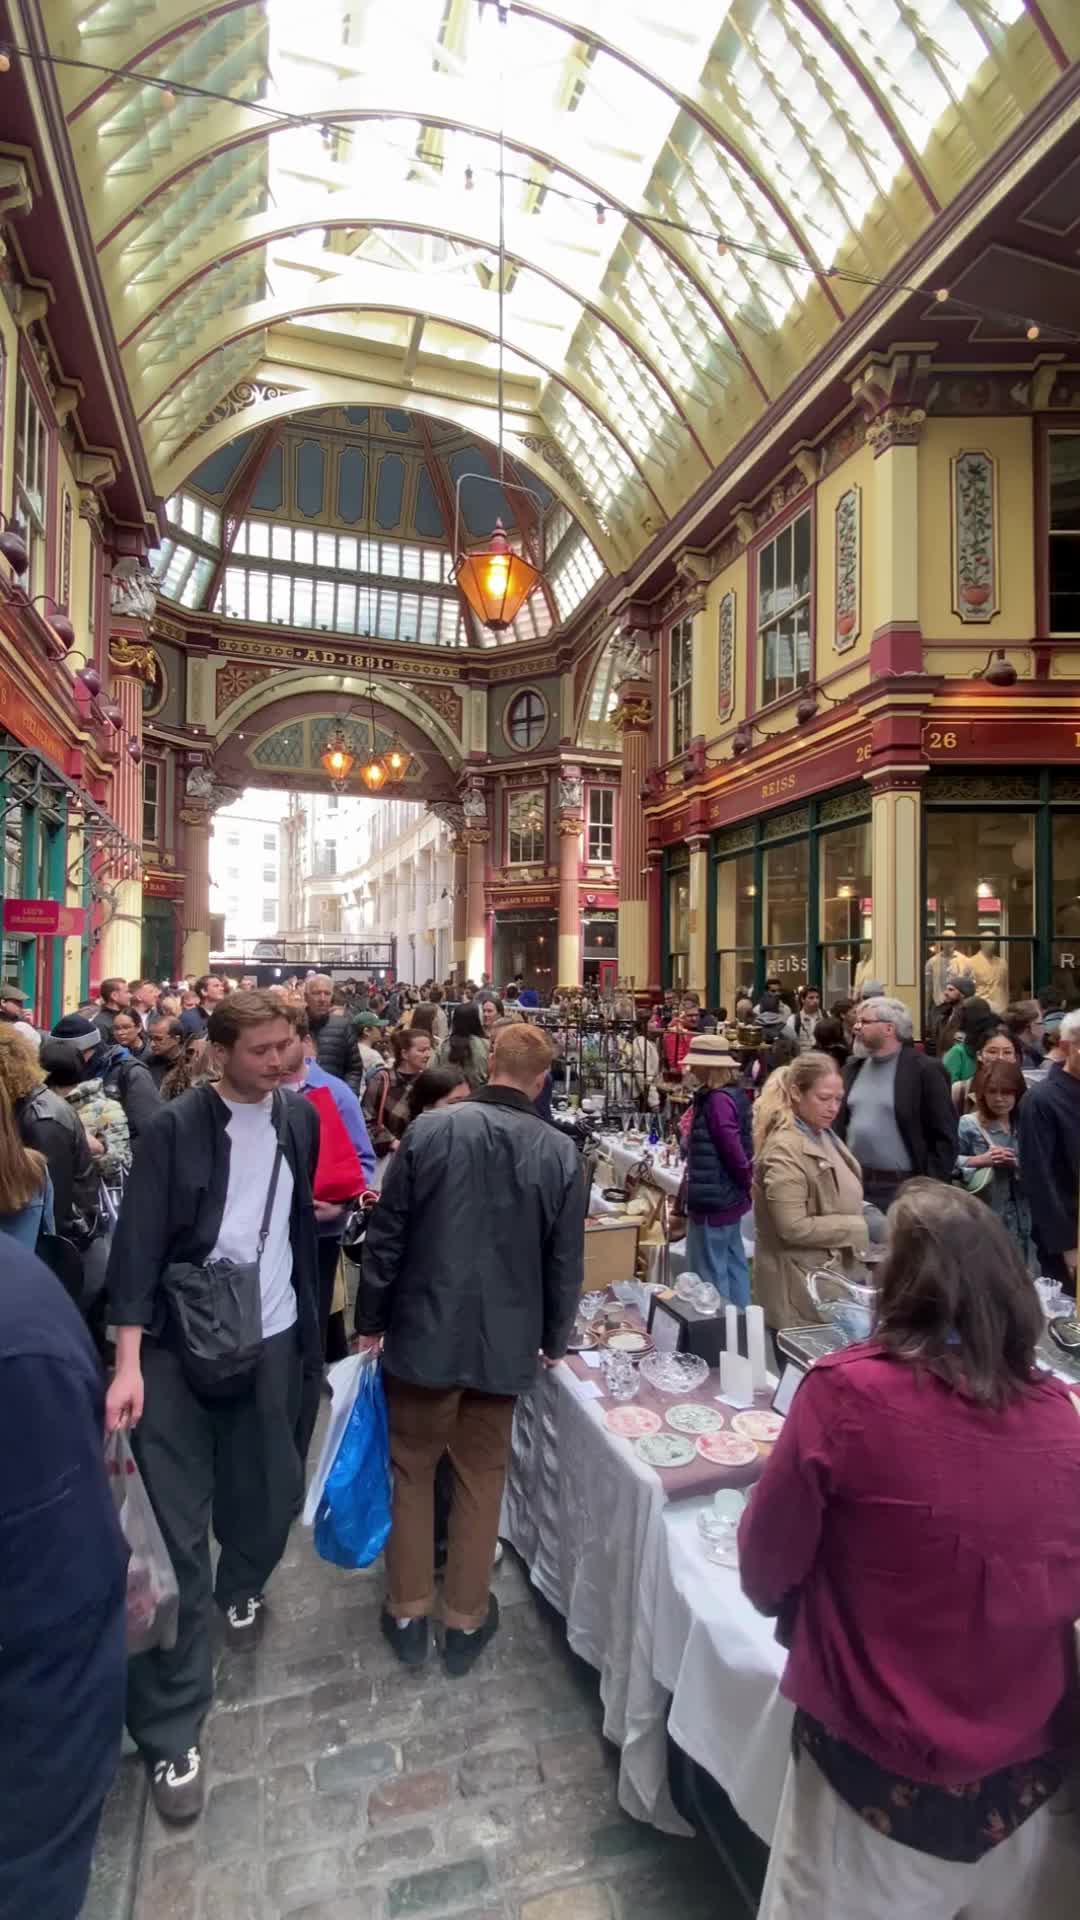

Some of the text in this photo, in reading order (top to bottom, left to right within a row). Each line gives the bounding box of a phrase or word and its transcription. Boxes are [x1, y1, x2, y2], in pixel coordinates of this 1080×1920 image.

[929, 732, 957, 748] 26
[761, 774, 796, 799] REISS
[768, 958, 807, 972] REISS
